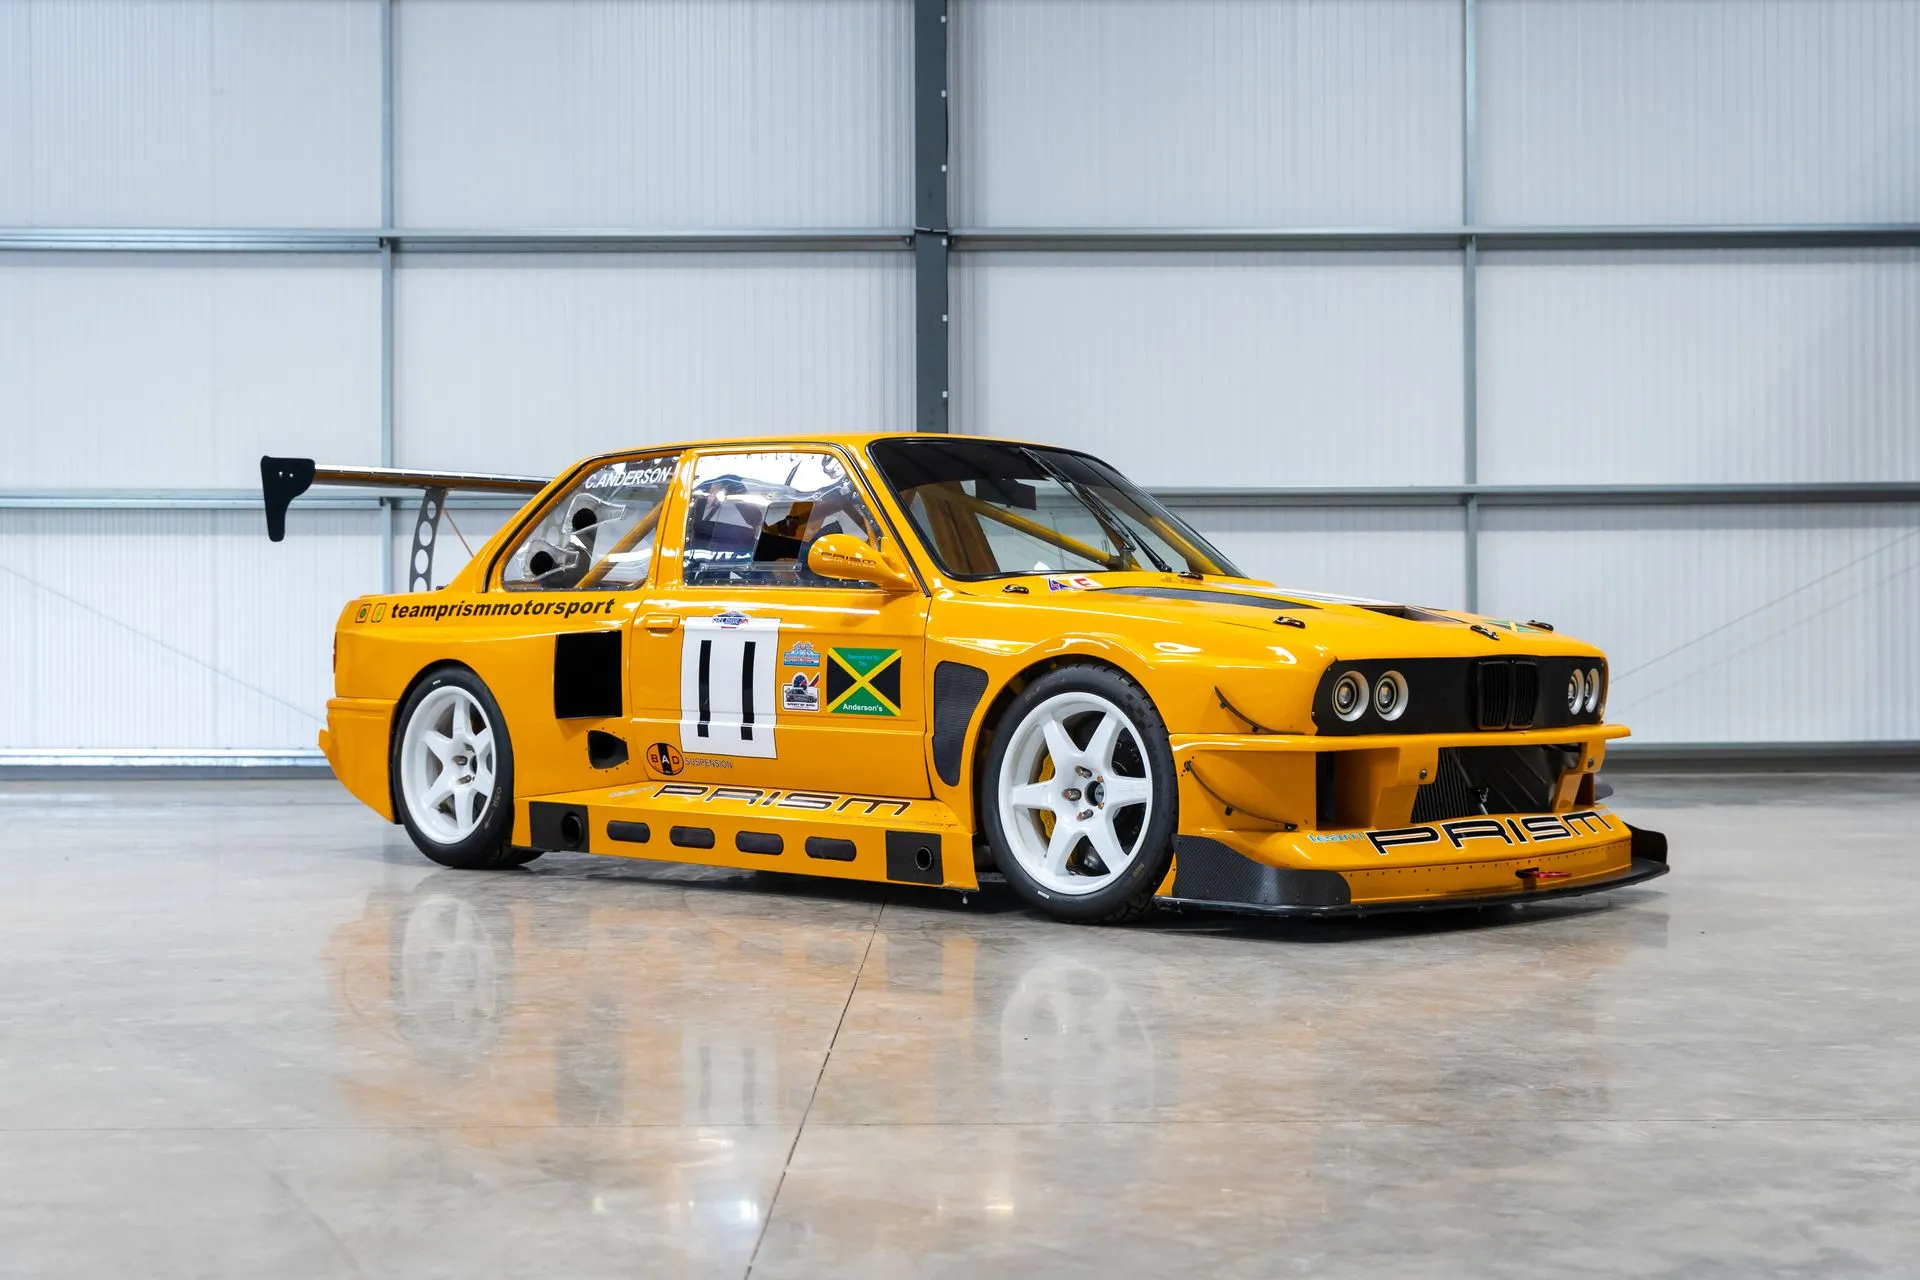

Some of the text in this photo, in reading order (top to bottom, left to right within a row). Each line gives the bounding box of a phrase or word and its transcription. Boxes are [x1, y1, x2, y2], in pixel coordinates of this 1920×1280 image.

[585, 466, 672, 489] C.ANDERSON
[391, 598, 615, 621] teamprismmotorsport
[842, 703, 883, 712] Anderson's
[650, 754, 733, 769] BAD SUSPENSION
[652, 784, 912, 815] PRISM
[1306, 811, 1614, 855] team PRISM
